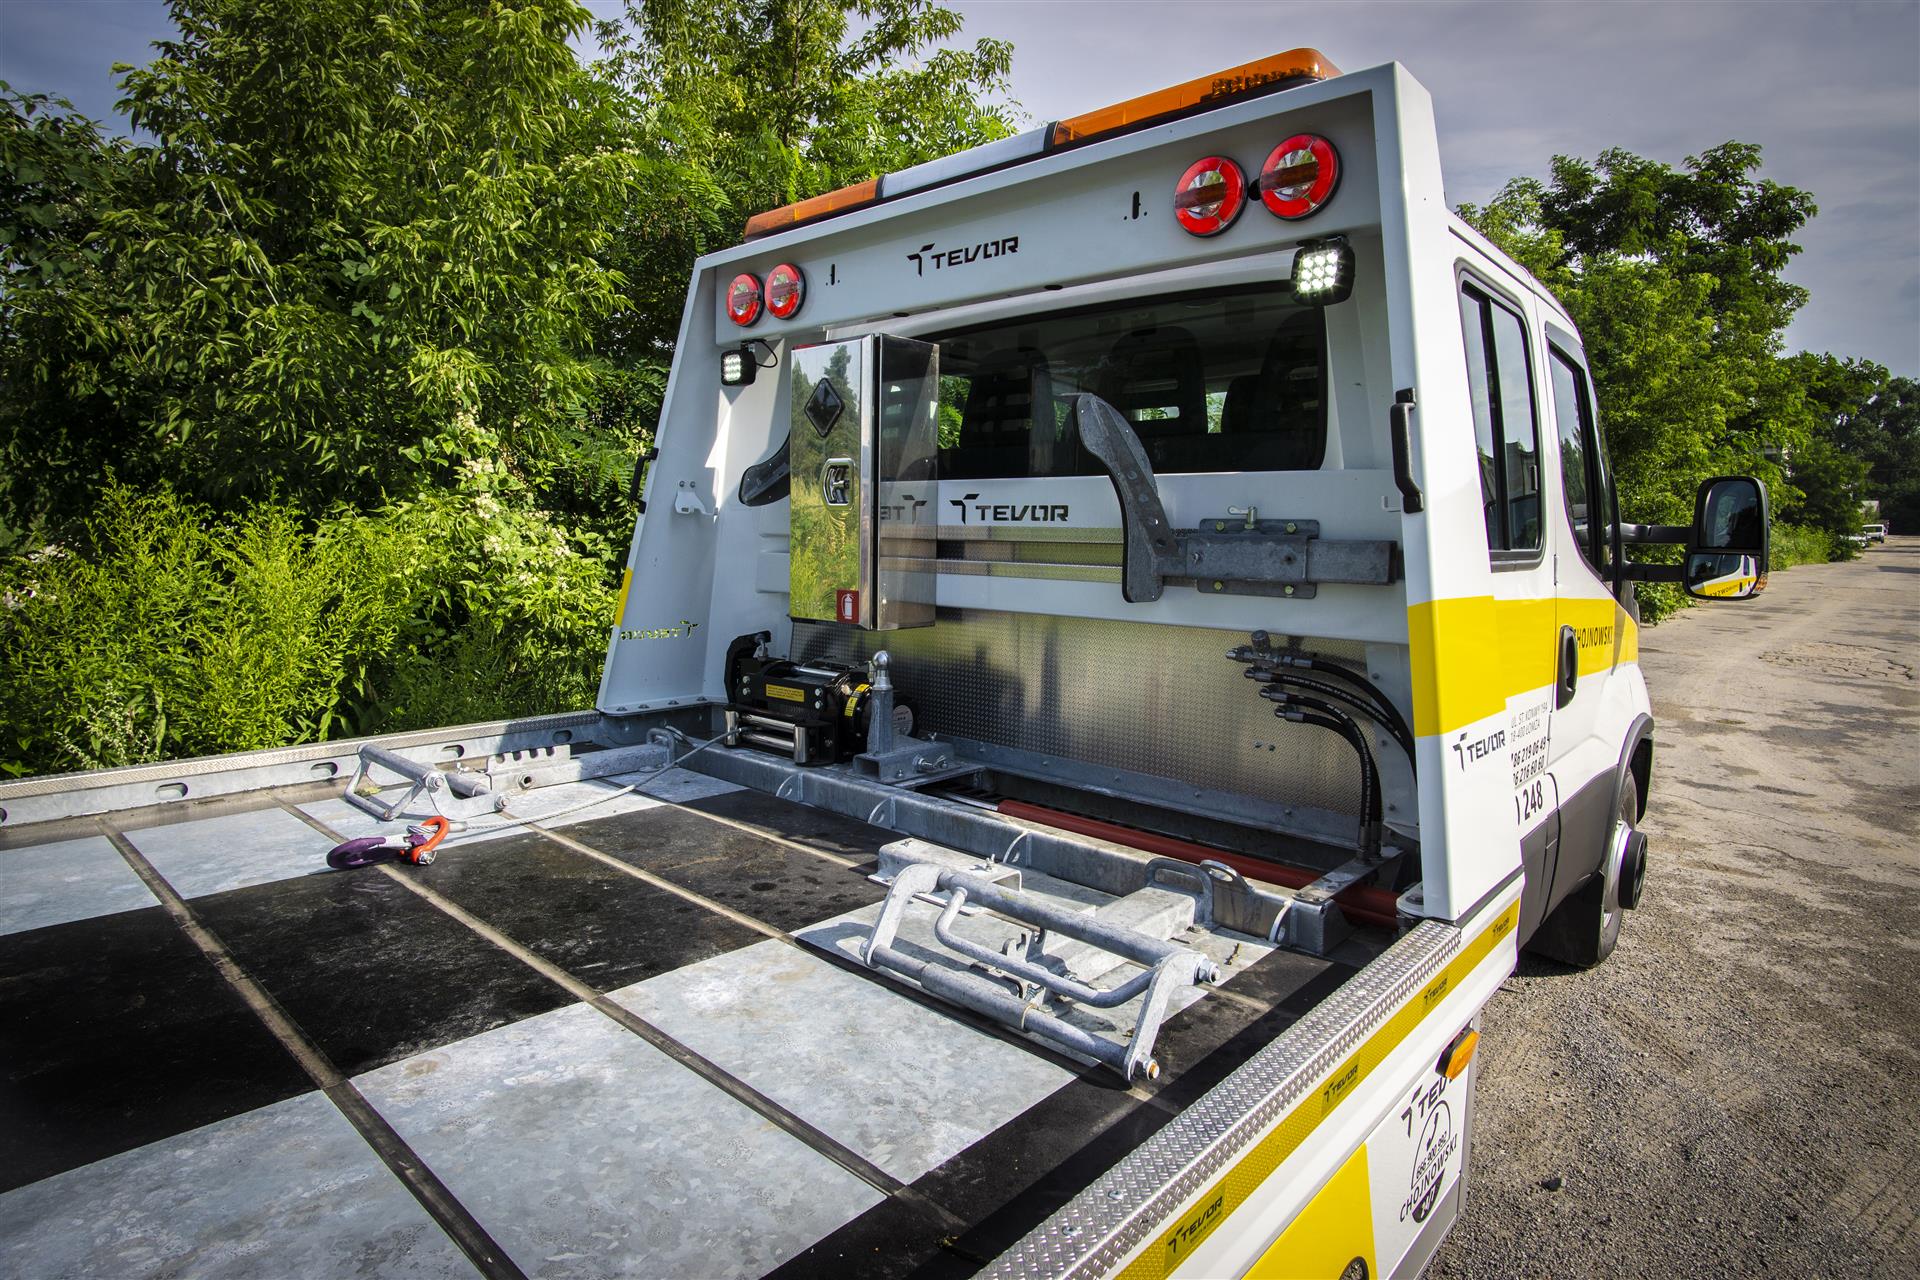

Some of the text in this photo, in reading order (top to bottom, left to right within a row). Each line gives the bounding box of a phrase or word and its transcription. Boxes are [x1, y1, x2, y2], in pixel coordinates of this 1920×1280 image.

[931, 236, 1019, 270] TEVOR
[975, 504, 1069, 522] TEVOR
[1466, 729, 1506, 763] TEVOR
[1523, 780, 1543, 821] 248
[1418, 1077, 1455, 1119] TEV
[1399, 1133, 1458, 1223] CHOJNOWSKI
[1181, 1195, 1223, 1242] TEVOR
